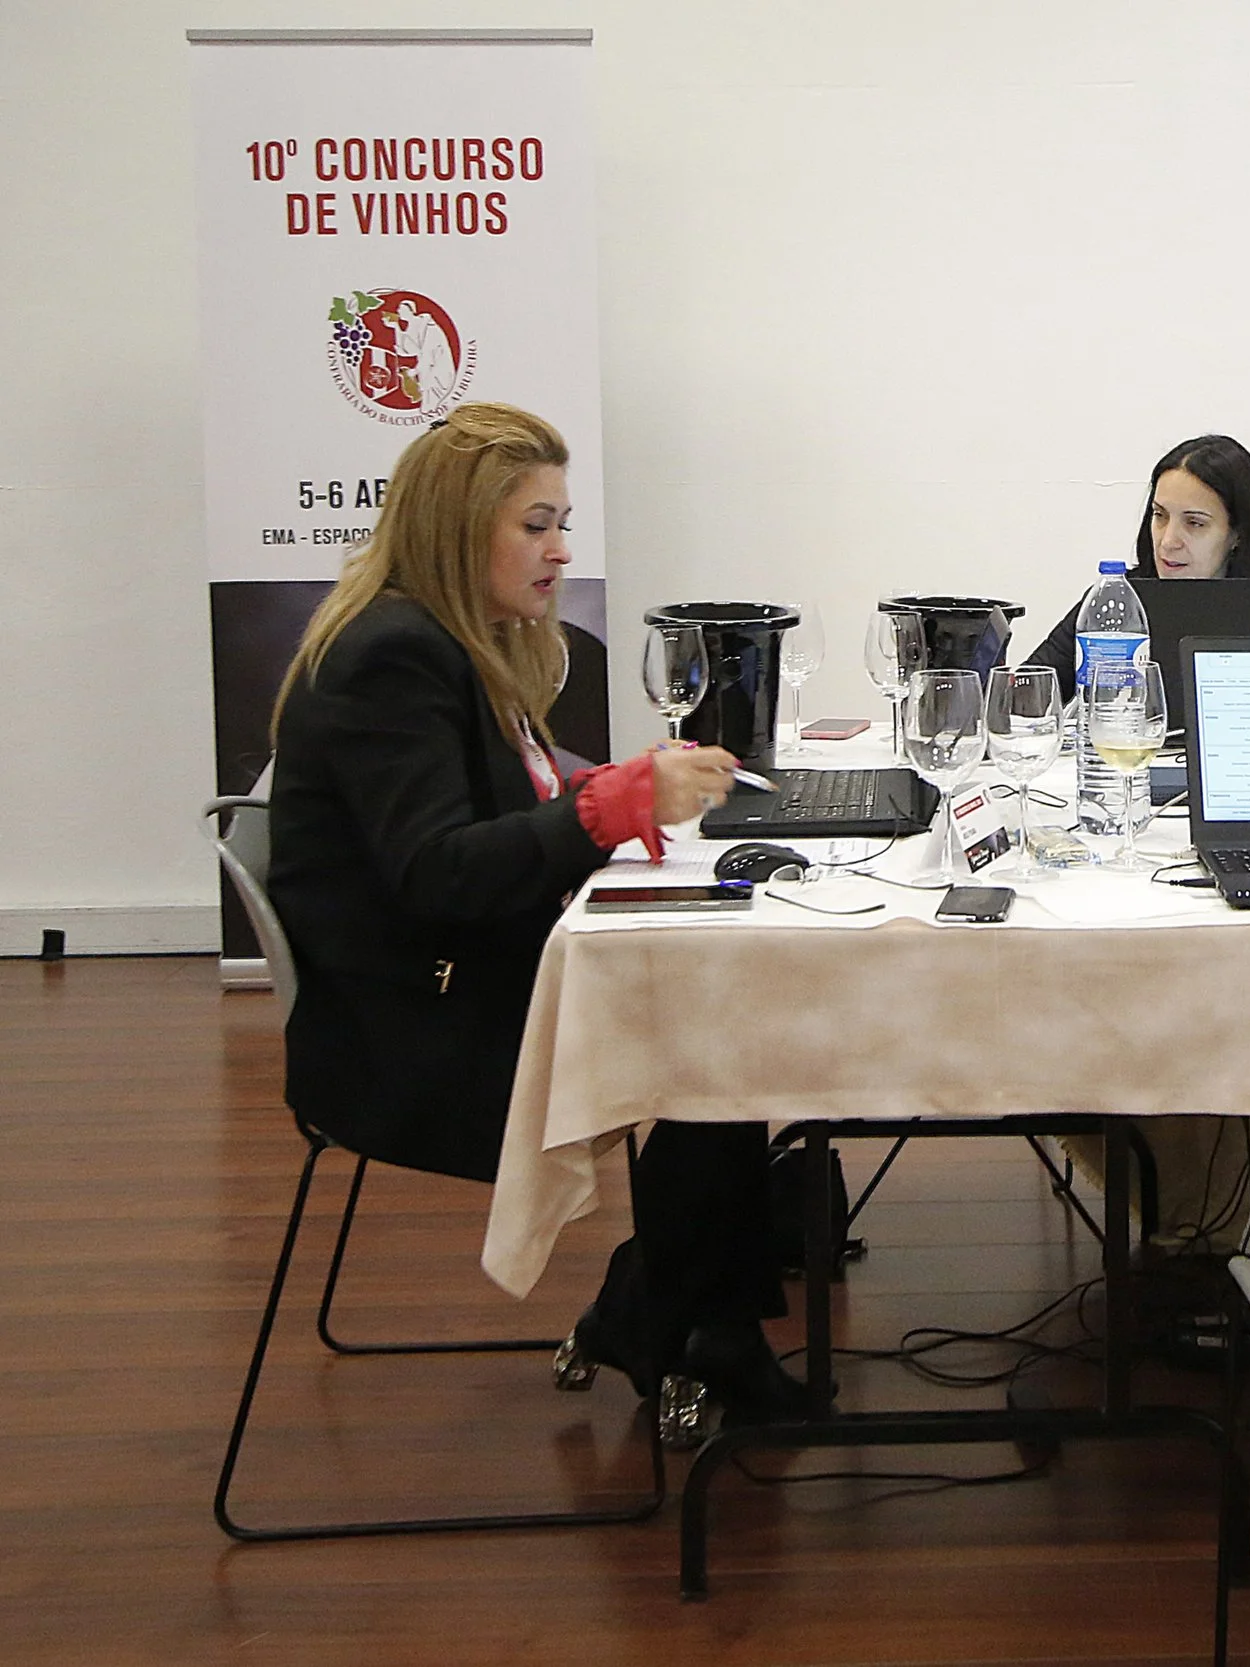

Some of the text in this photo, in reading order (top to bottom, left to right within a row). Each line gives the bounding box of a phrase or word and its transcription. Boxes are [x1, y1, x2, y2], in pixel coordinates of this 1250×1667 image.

[315, 138, 543, 181] CONCURSO
[287, 193, 508, 235] DE VINHOS
[327, 341, 360, 408] CONFRARIA
[359, 403, 377, 418] DO
[450, 338, 478, 402] ALBUFEIRA
[299, 478, 388, 510] 5-6 AB
[262, 528, 296, 545] EMA
